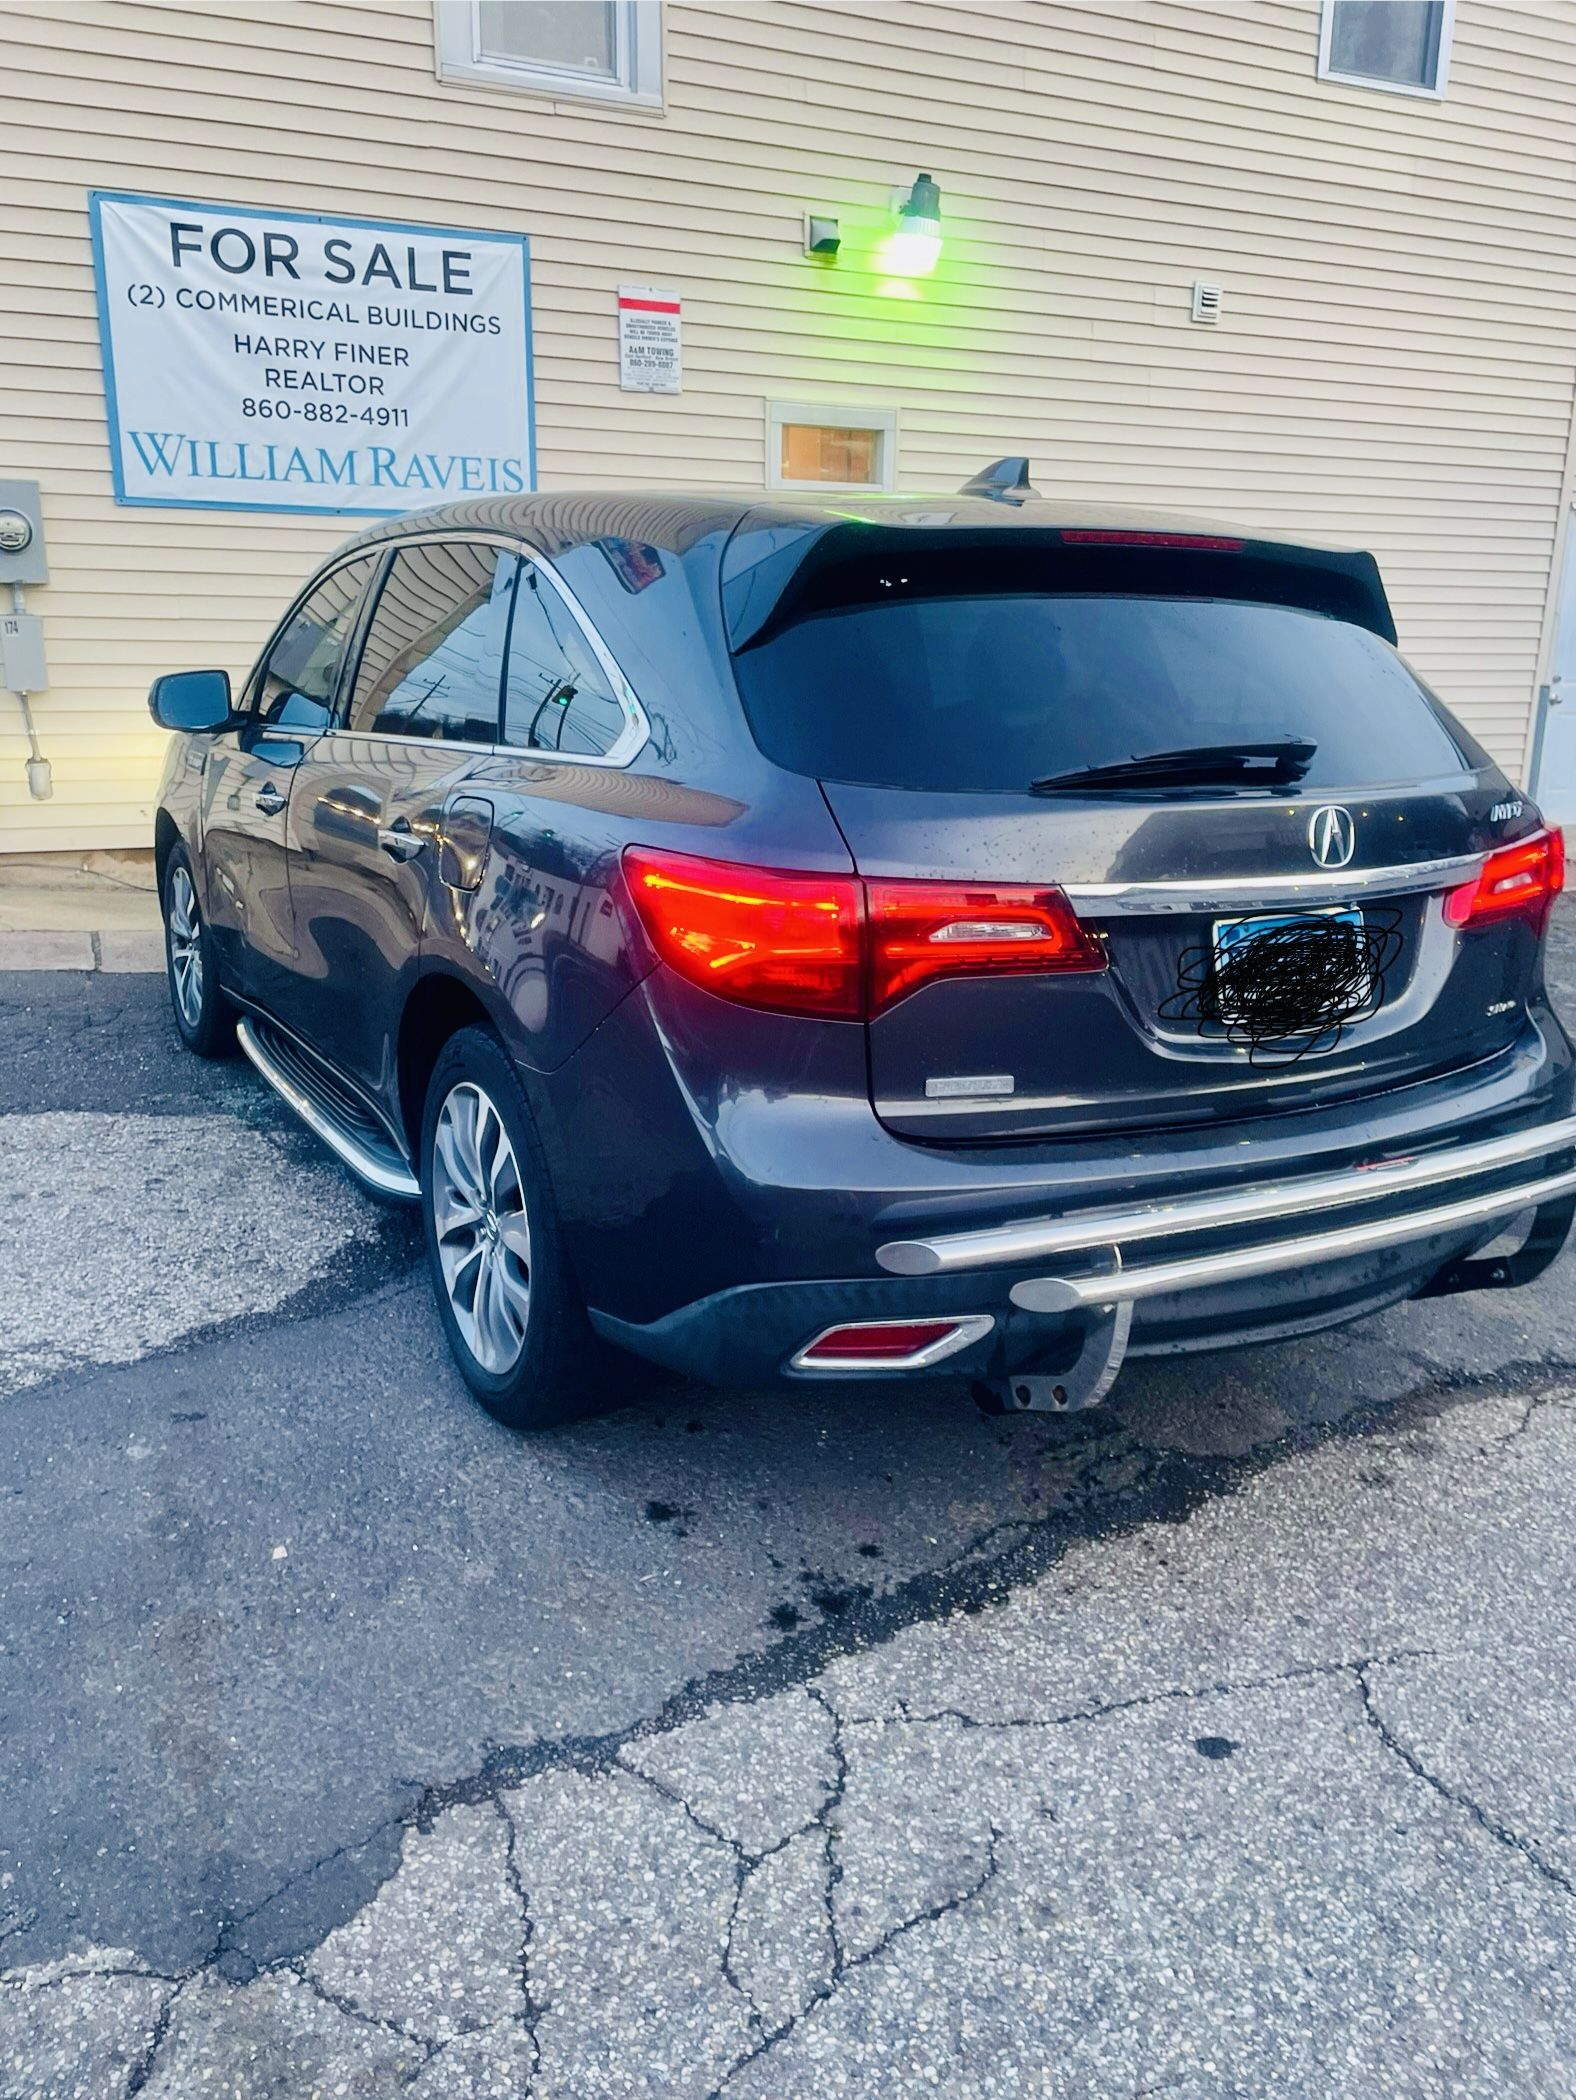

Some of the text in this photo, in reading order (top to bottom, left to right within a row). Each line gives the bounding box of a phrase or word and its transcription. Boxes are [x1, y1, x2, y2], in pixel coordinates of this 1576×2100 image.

[169, 221, 474, 296] FOR SALE
[127, 283, 502, 336] (2) COMMERICAL BUILDINGS
[233, 333, 410, 367] HARRY FINER
[647, 347, 674, 357] TOWING
[264, 367, 385, 396] REALTOR
[242, 397, 409, 428] 860-882-4911
[127, 431, 524, 492] WILLIAM RAVEIS
